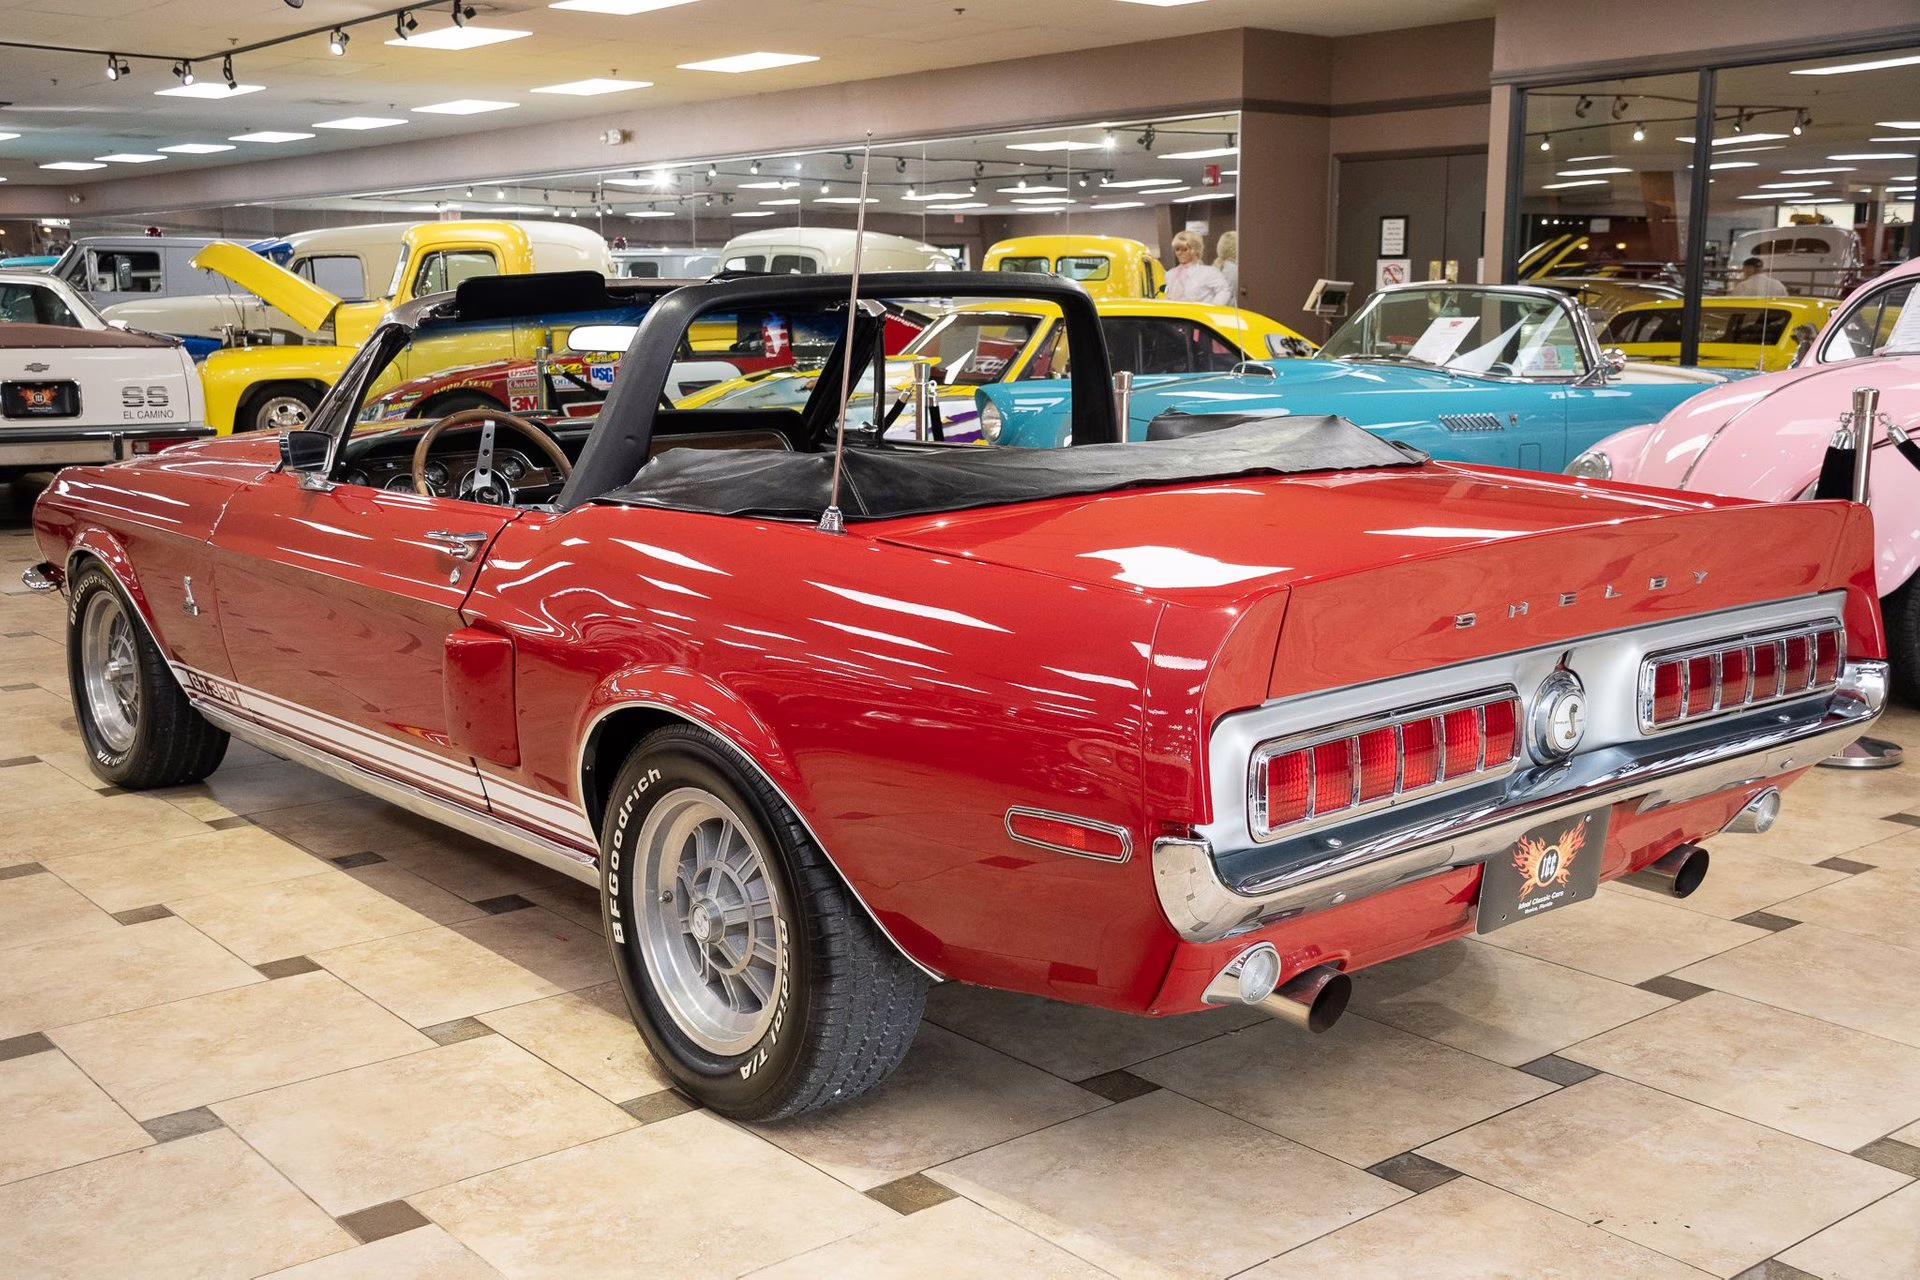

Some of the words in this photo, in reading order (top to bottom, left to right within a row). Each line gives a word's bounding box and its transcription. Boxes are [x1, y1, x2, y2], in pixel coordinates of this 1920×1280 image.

[591, 367, 613, 383] USG
[122, 385, 169, 408] SS
[512, 396, 538, 411] 3M
[123, 411, 135, 419] EL
[137, 409, 174, 419] CAMINO
[1455, 570, 1709, 630] SHELBY
[1532, 895, 1551, 905] Classic
[1551, 891, 1564, 899] Cars
[770, 916, 791, 1045] Radial
[739, 1047, 769, 1081] T/A
